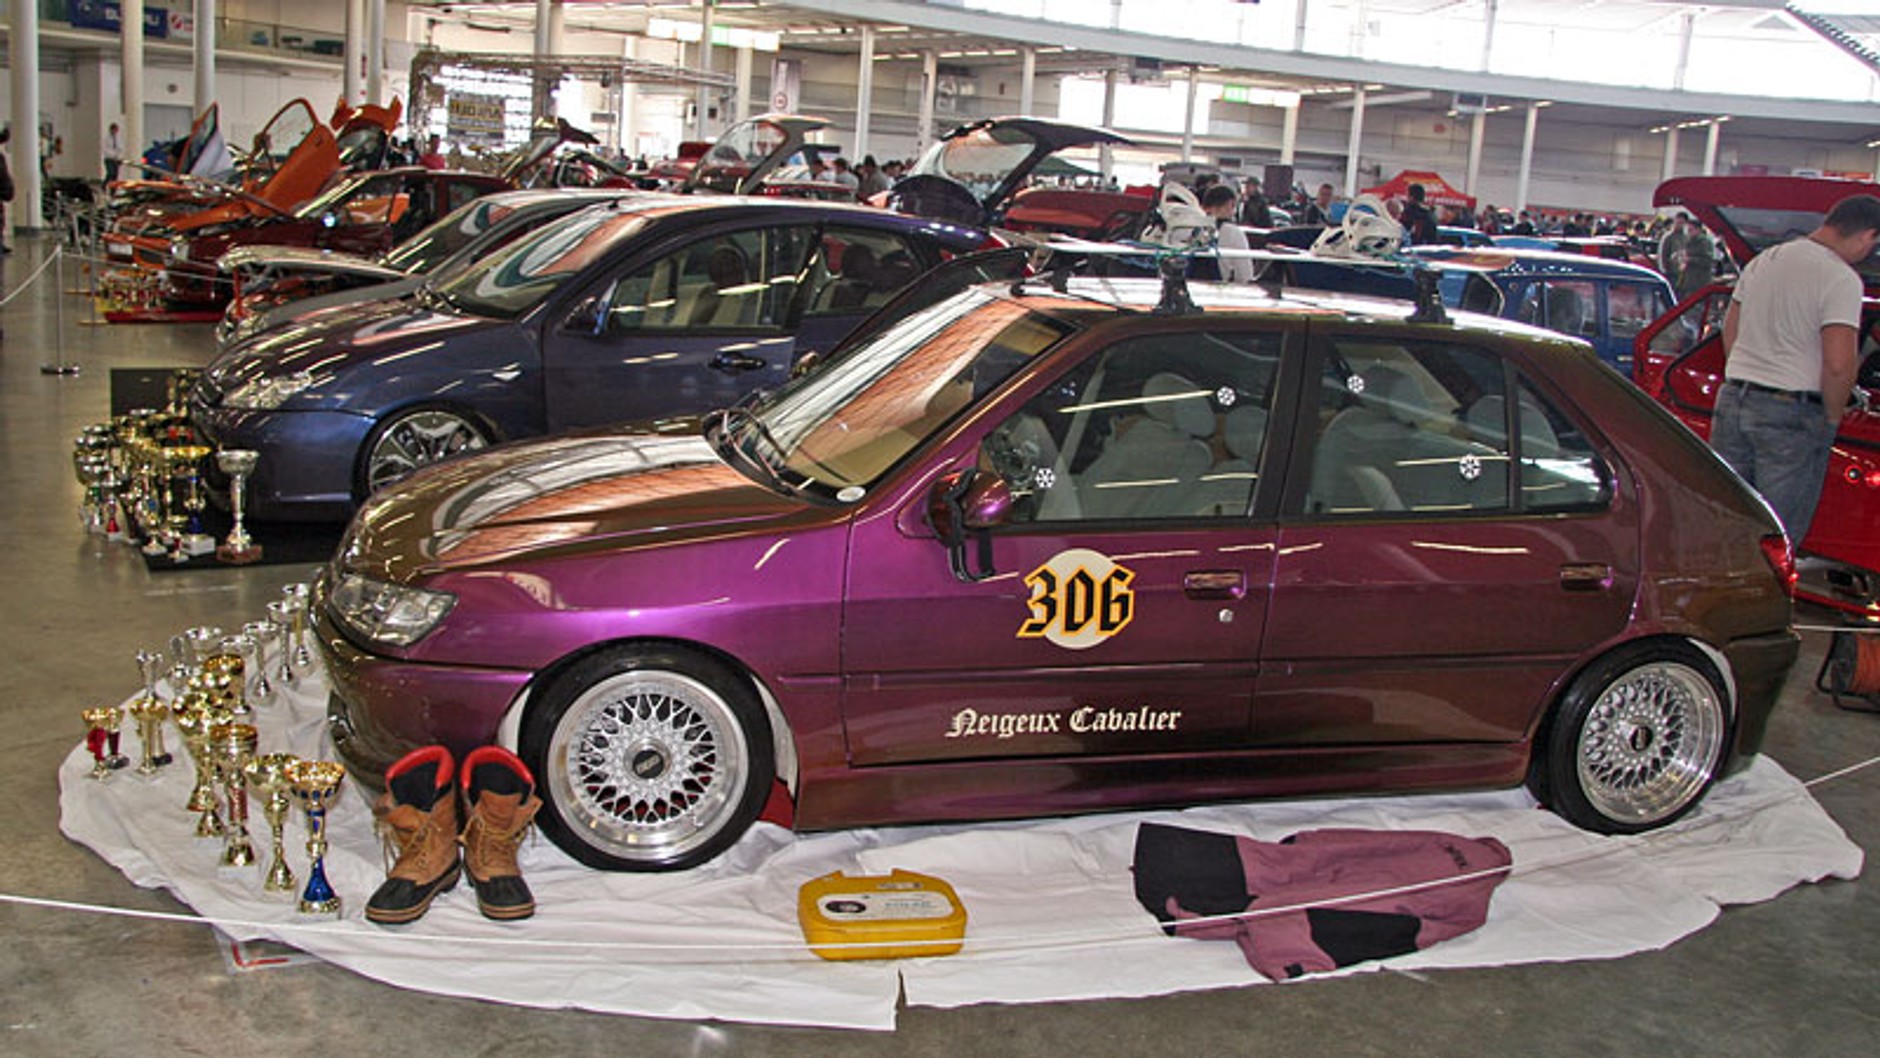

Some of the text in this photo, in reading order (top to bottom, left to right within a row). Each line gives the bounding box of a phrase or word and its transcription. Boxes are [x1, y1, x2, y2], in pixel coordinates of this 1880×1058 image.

[1016, 564, 1137, 638] 306
[945, 705, 1182, 738] Neigeux Cavalier
